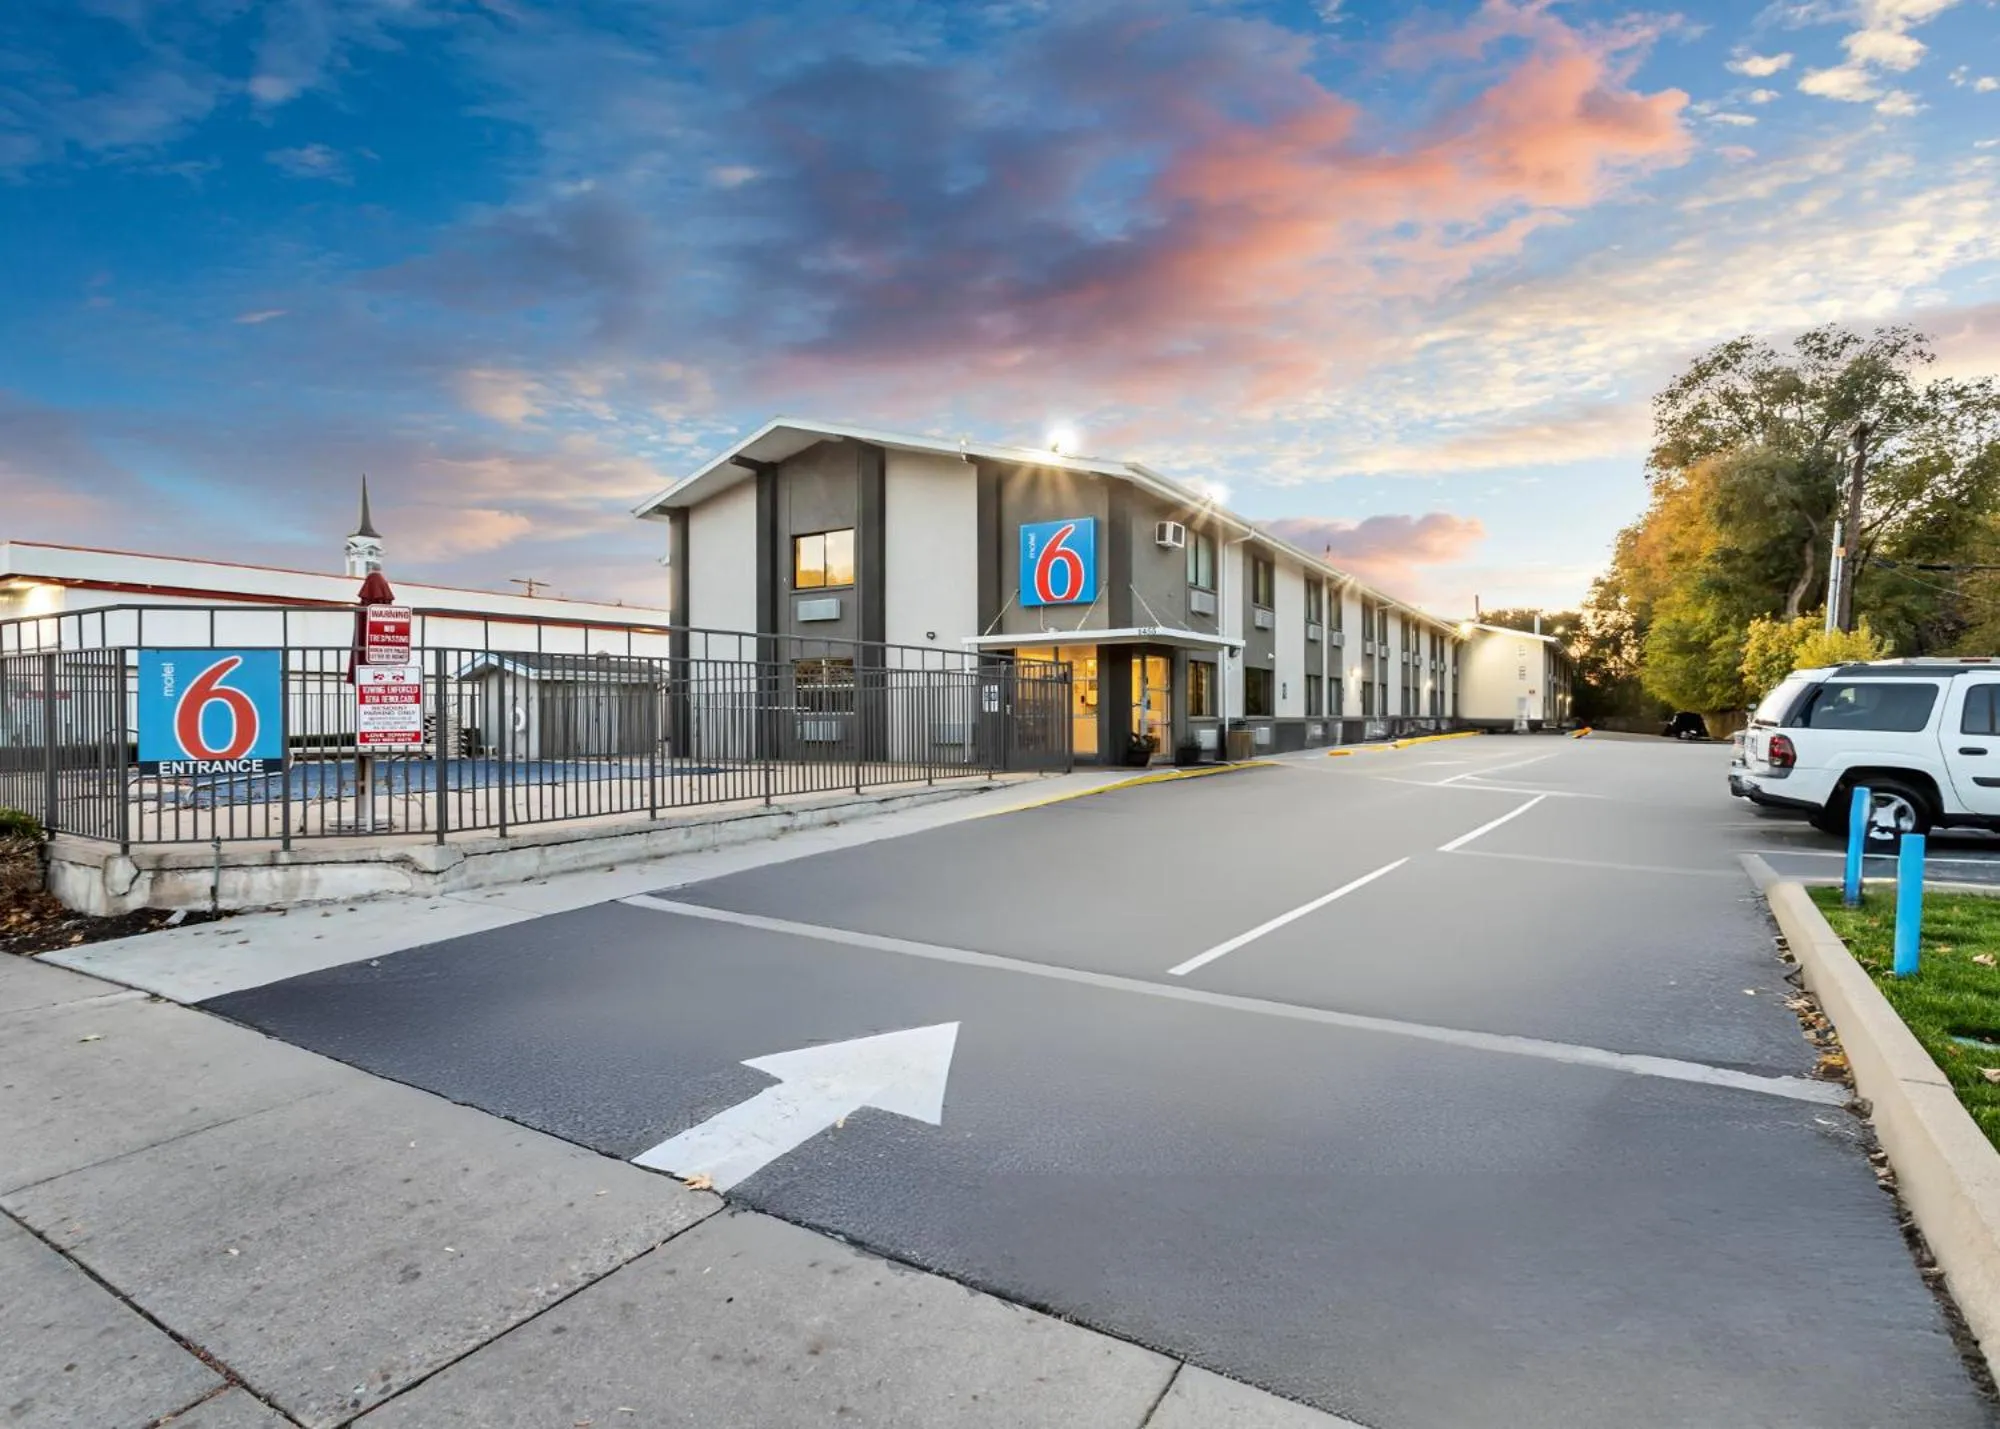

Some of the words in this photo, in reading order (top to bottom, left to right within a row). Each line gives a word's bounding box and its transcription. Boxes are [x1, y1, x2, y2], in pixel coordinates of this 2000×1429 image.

[1034, 524, 1085, 603] 6
[371, 610, 409, 619] WARNING
[383, 625, 396, 633] NO
[369, 635, 409, 643] TRESPASSING
[362, 686, 386, 694] TOWING
[387, 686, 418, 694] ENFORCED
[161, 663, 175, 697] motel
[174, 655, 260, 760] 6
[158, 760, 264, 775] ENTRANCE
